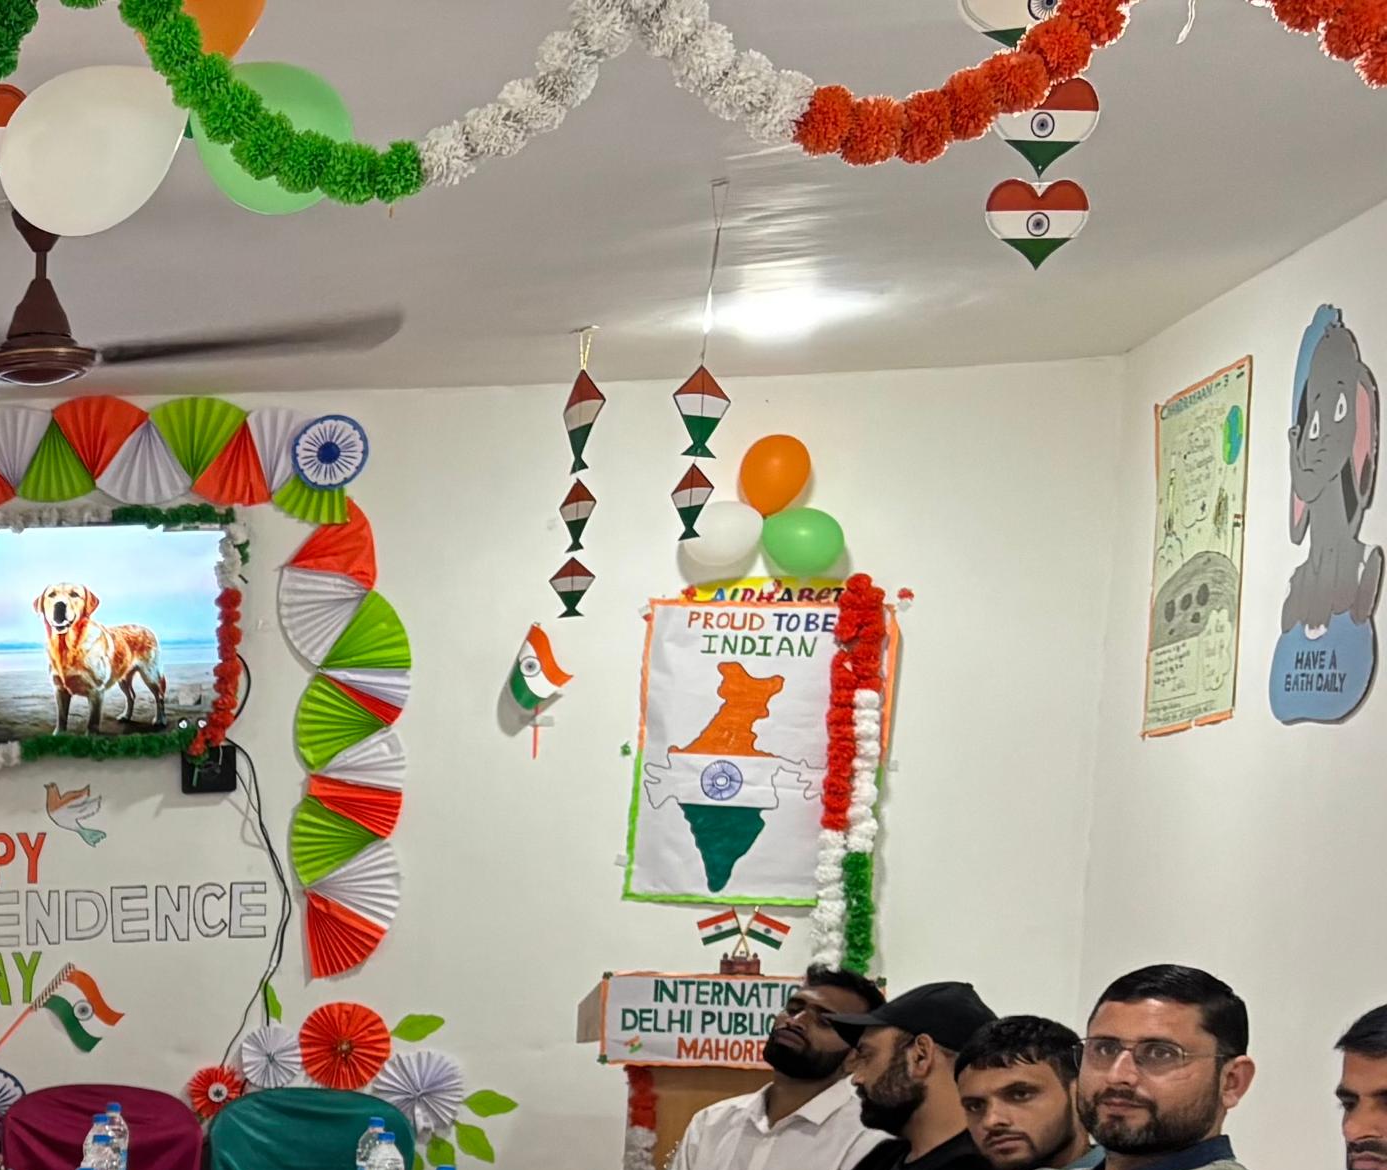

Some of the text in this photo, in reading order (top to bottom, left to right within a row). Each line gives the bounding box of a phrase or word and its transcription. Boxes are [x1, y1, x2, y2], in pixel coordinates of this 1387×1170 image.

[688, 611, 836, 632] PROUD TO BE
[700, 634, 817, 657] INDIAN
[1294, 649, 1337, 670] HAVE A
[1284, 672, 1347, 692] BATH DAILY
[621, 1008, 692, 1033] DELHI
[676, 1037, 765, 1062] MAHORE
